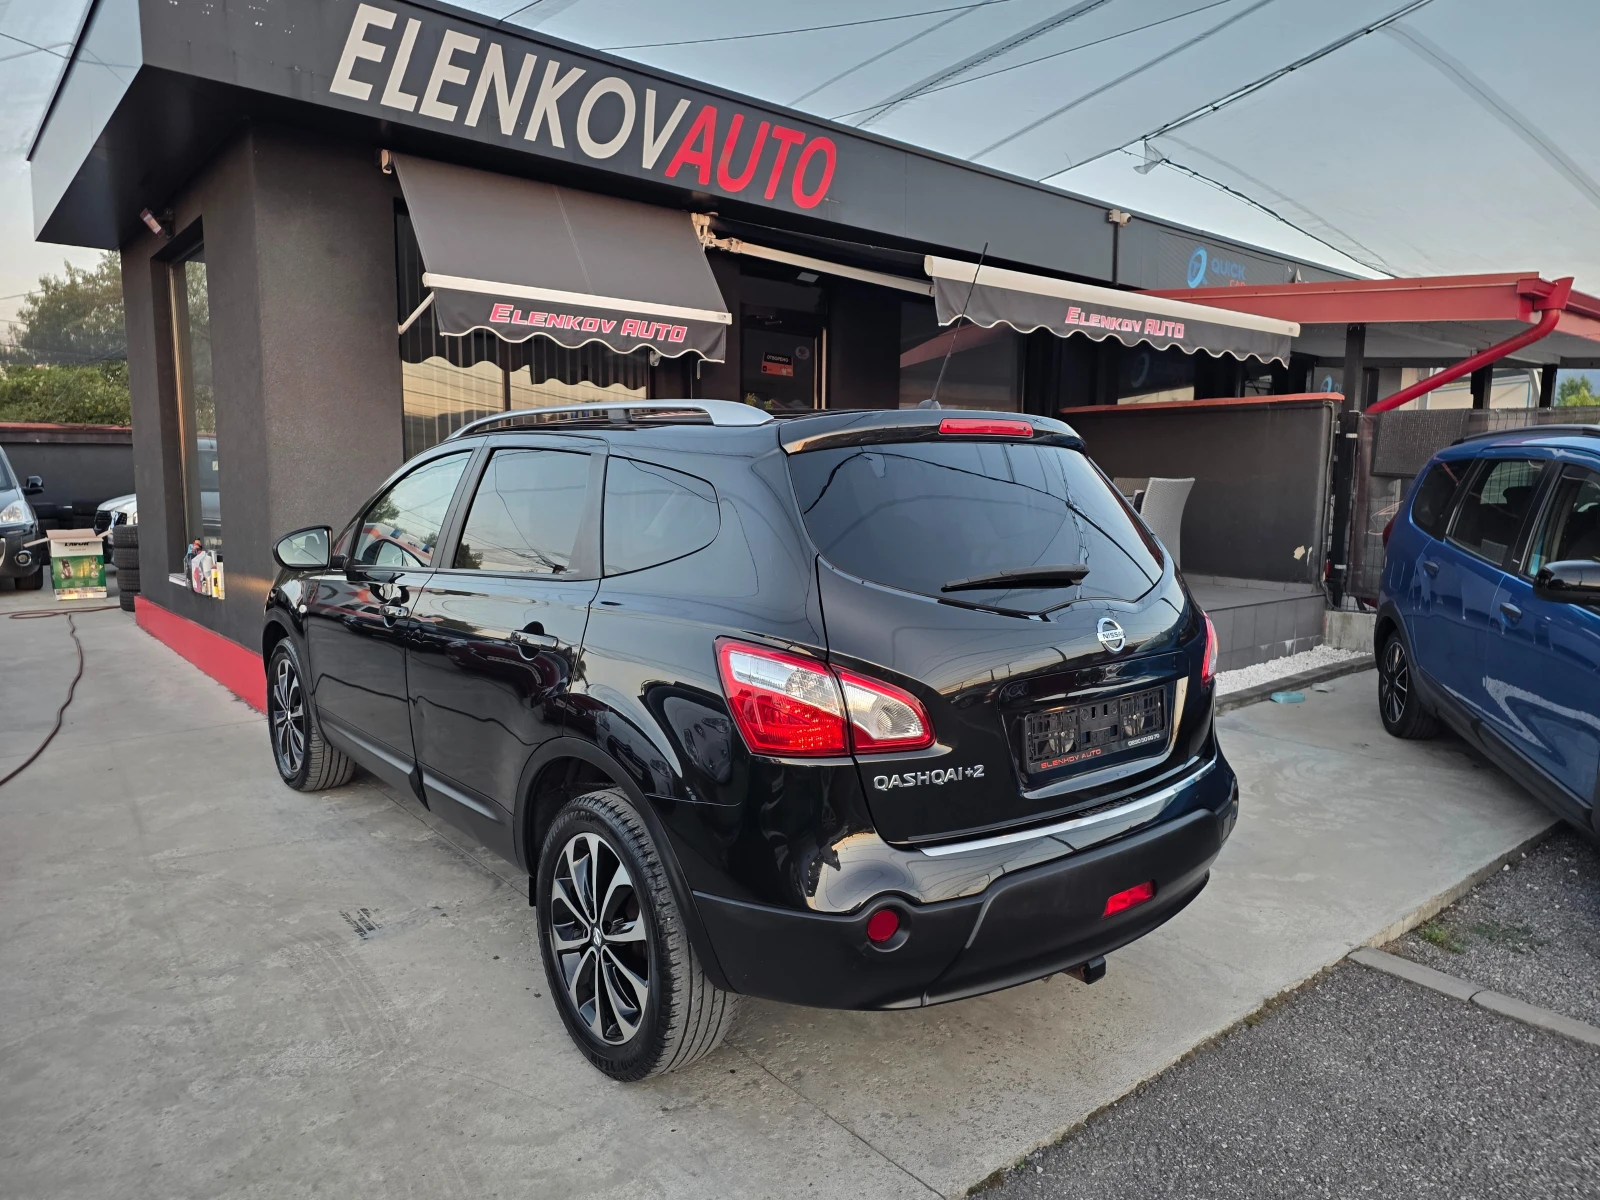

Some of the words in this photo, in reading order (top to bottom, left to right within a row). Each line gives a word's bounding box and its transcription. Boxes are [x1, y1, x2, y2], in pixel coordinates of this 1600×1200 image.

[1211, 258, 1246, 280] QUICK
[621, 318, 688, 343] AUTO
[1144, 318, 1184, 339] AUTO
[1081, 748, 1102, 759] AUTO
